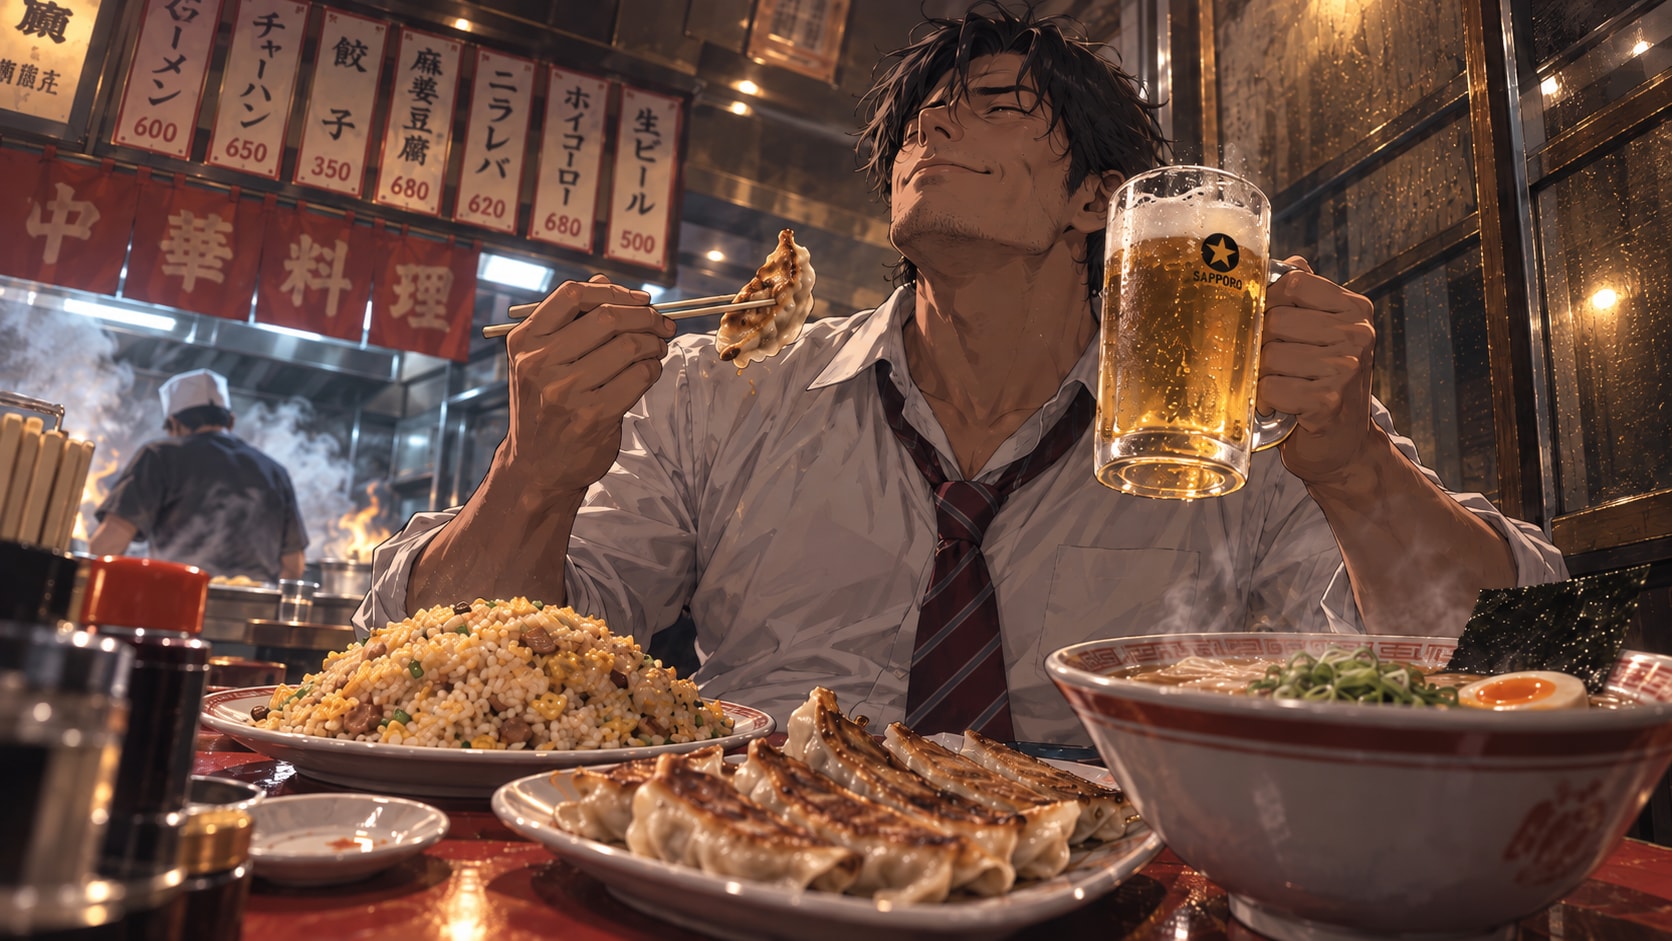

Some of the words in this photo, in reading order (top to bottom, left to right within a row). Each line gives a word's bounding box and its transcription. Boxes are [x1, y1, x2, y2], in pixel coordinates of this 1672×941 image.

[240, 12, 286, 128] チャーハン
[322, 36, 368, 140] 餃子
[133, 116, 178, 143] 600
[475, 70, 517, 178] ニラレバ
[225, 137, 268, 163] 650
[558, 86, 591, 206] ホイコーロー
[311, 156, 351, 182] 350
[626, 107, 661, 215] 生ビール
[390, 175, 429, 201] 680
[468, 193, 505, 219] 620
[544, 212, 582, 237] 680
[620, 230, 655, 253] 500
[26, 182, 454, 333] 中華料理
[1193, 270, 1242, 290] SAPPORO
